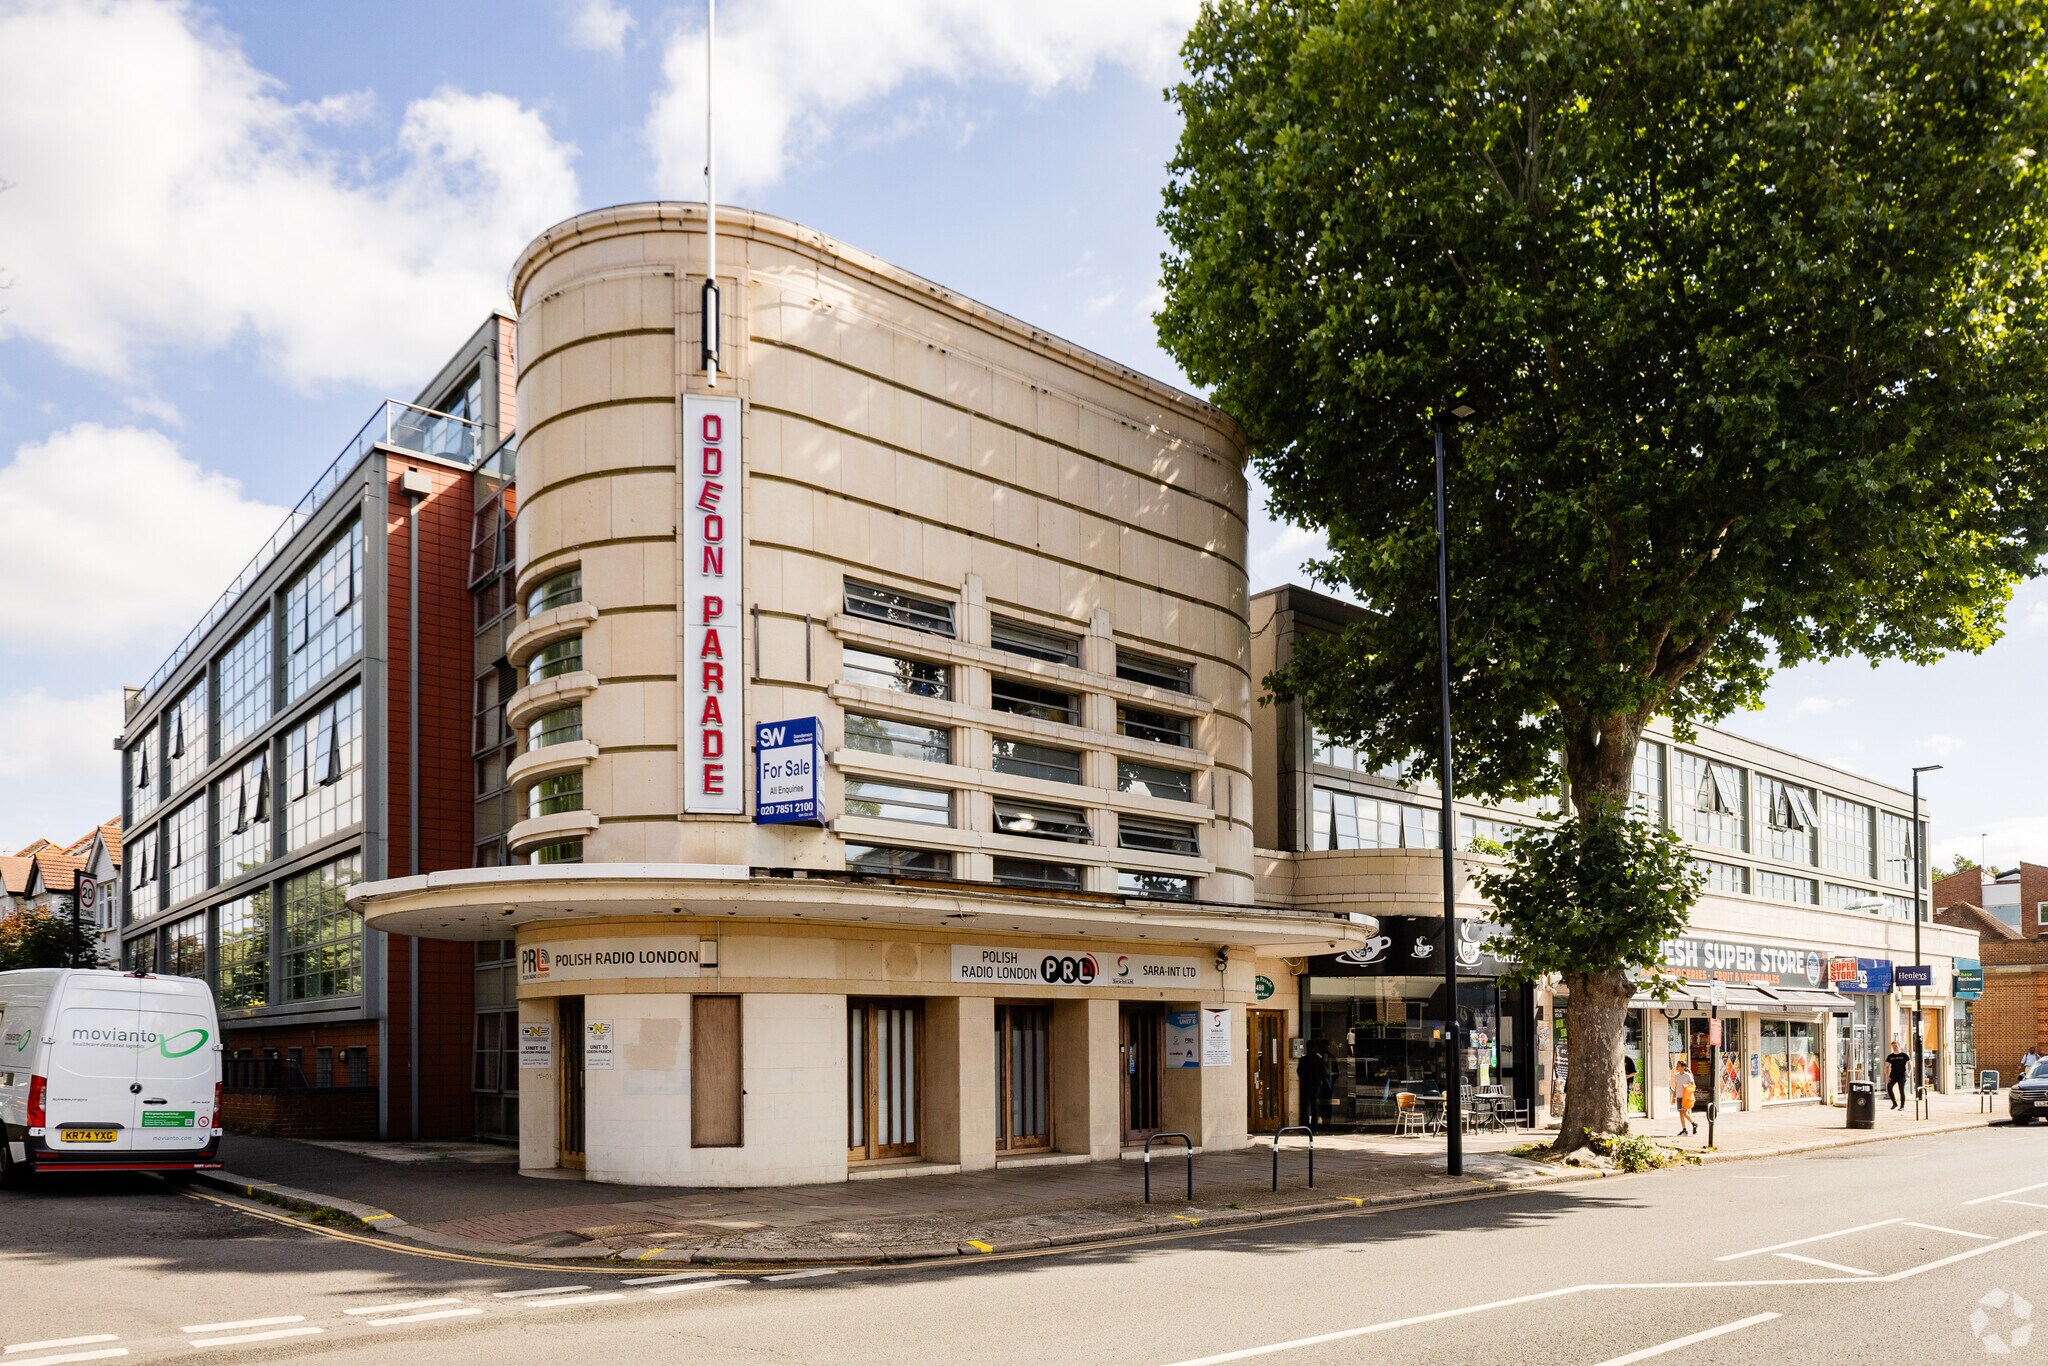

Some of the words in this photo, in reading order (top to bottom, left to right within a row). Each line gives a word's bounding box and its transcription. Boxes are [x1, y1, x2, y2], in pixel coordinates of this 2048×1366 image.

[697, 414, 724, 577] ODEON
[701, 595, 724, 795] PARADE
[760, 726, 786, 748] SW
[763, 762, 783, 779] For
[785, 758, 810, 777] Sale
[778, 784, 804, 795] Enquiries
[760, 806, 775, 816] 020
[775, 803, 793, 814] 7851
[795, 801, 813, 813] 2100
[82, 886, 93, 900] 20
[80, 908, 94, 918] ZONE
[522, 948, 550, 973] PRL
[555, 953, 592, 967] POLISH
[596, 951, 635, 965] RADIO
[639, 950, 699, 964] LONDON
[982, 950, 1018, 964] POLISH
[1656, 940, 1698, 968] ESH
[1704, 942, 1756, 971] SUPER
[1761, 947, 1805, 975] STORE
[961, 965, 993, 978] RADIO
[997, 966, 1037, 980] LONDON
[1044, 958, 1094, 982] PRL
[1143, 965, 1181, 977] SARA-INT
[1182, 967, 1196, 978] LTD
[1830, 962, 1856, 972] SUPER
[1640, 966, 1665, 977] ASI
[1666, 967, 1707, 980] GROCERIES
[1714, 970, 1734, 982] FRUIT
[1735, 972, 1740, 982] &
[1741, 972, 1780, 984] VEGETABLES
[1830, 970, 1856, 981] STORE
[1898, 971, 1928, 981] Henleys
[72, 1028, 157, 1043] movianto
[522, 1026, 550, 1037] DNS
[587, 1023, 611, 1035] DNS
[65, 1131, 92, 1140] KR74
[94, 1131, 113, 1140] YXG
